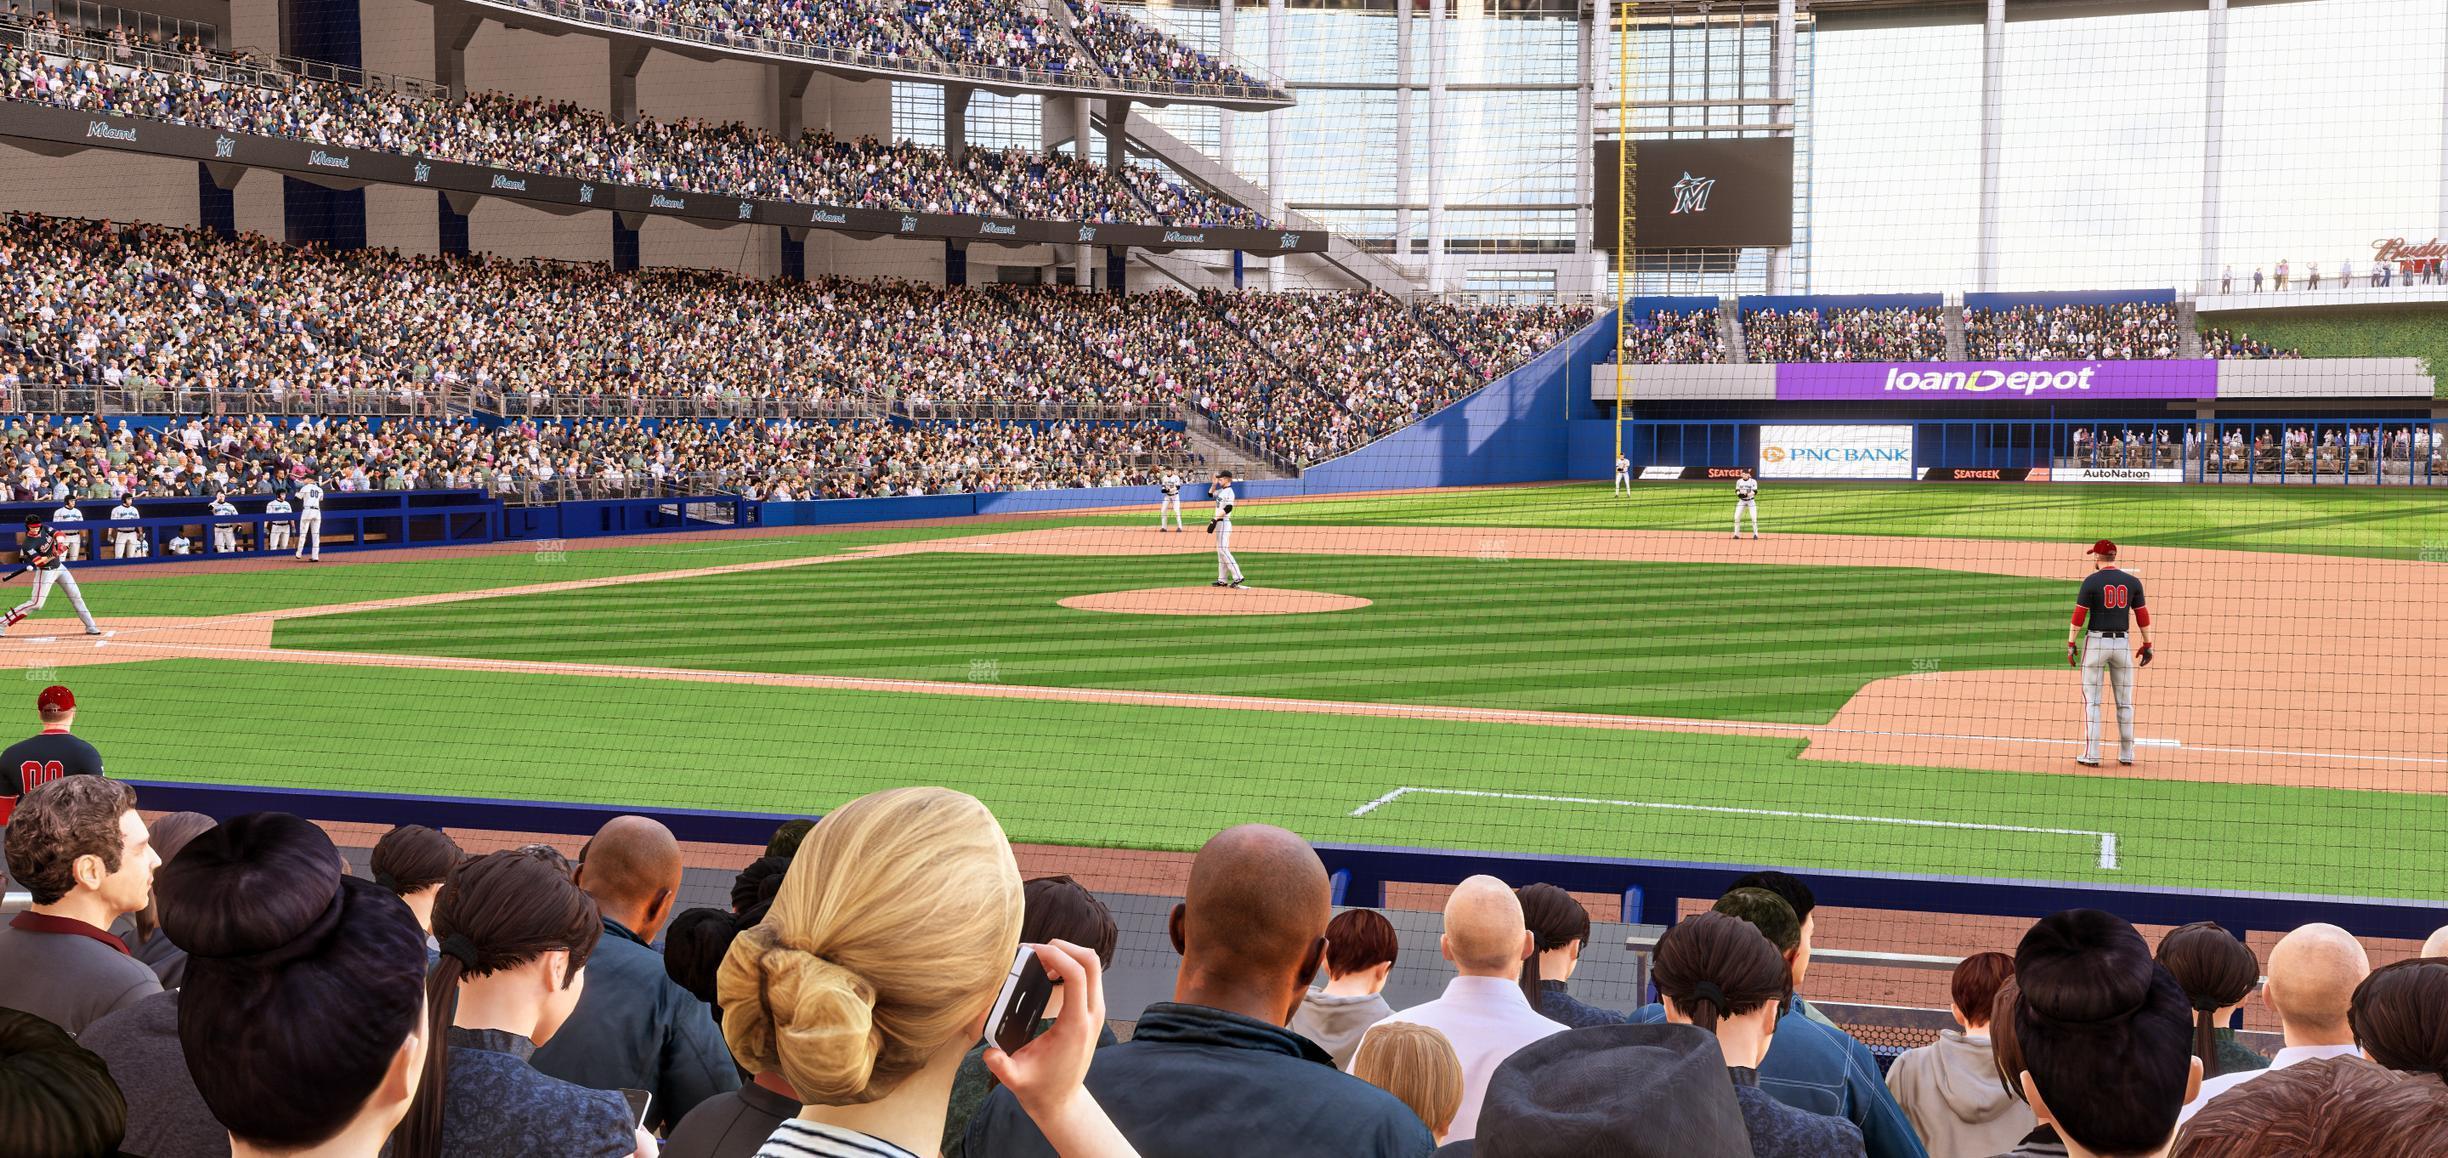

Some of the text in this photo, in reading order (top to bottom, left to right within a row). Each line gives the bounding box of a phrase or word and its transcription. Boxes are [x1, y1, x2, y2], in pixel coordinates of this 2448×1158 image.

[86, 120, 137, 142] Miami
[308, 150, 350, 169] Miami
[491, 174, 526, 191] Miami
[650, 194, 685, 210] Miami
[811, 210, 846, 224] Miami
[979, 222, 1016, 235] Miami
[1163, 230, 1204, 243] Miami
[1884, 367, 2095, 396] loanDepot
[1791, 448, 1909, 461] PNC BANK
[1708, 468, 1752, 479] SEATGE
[1953, 468, 2000, 480] SEATGEEK
[2083, 468, 2150, 479] AutoNation
[2104, 585, 2128, 608] 00
